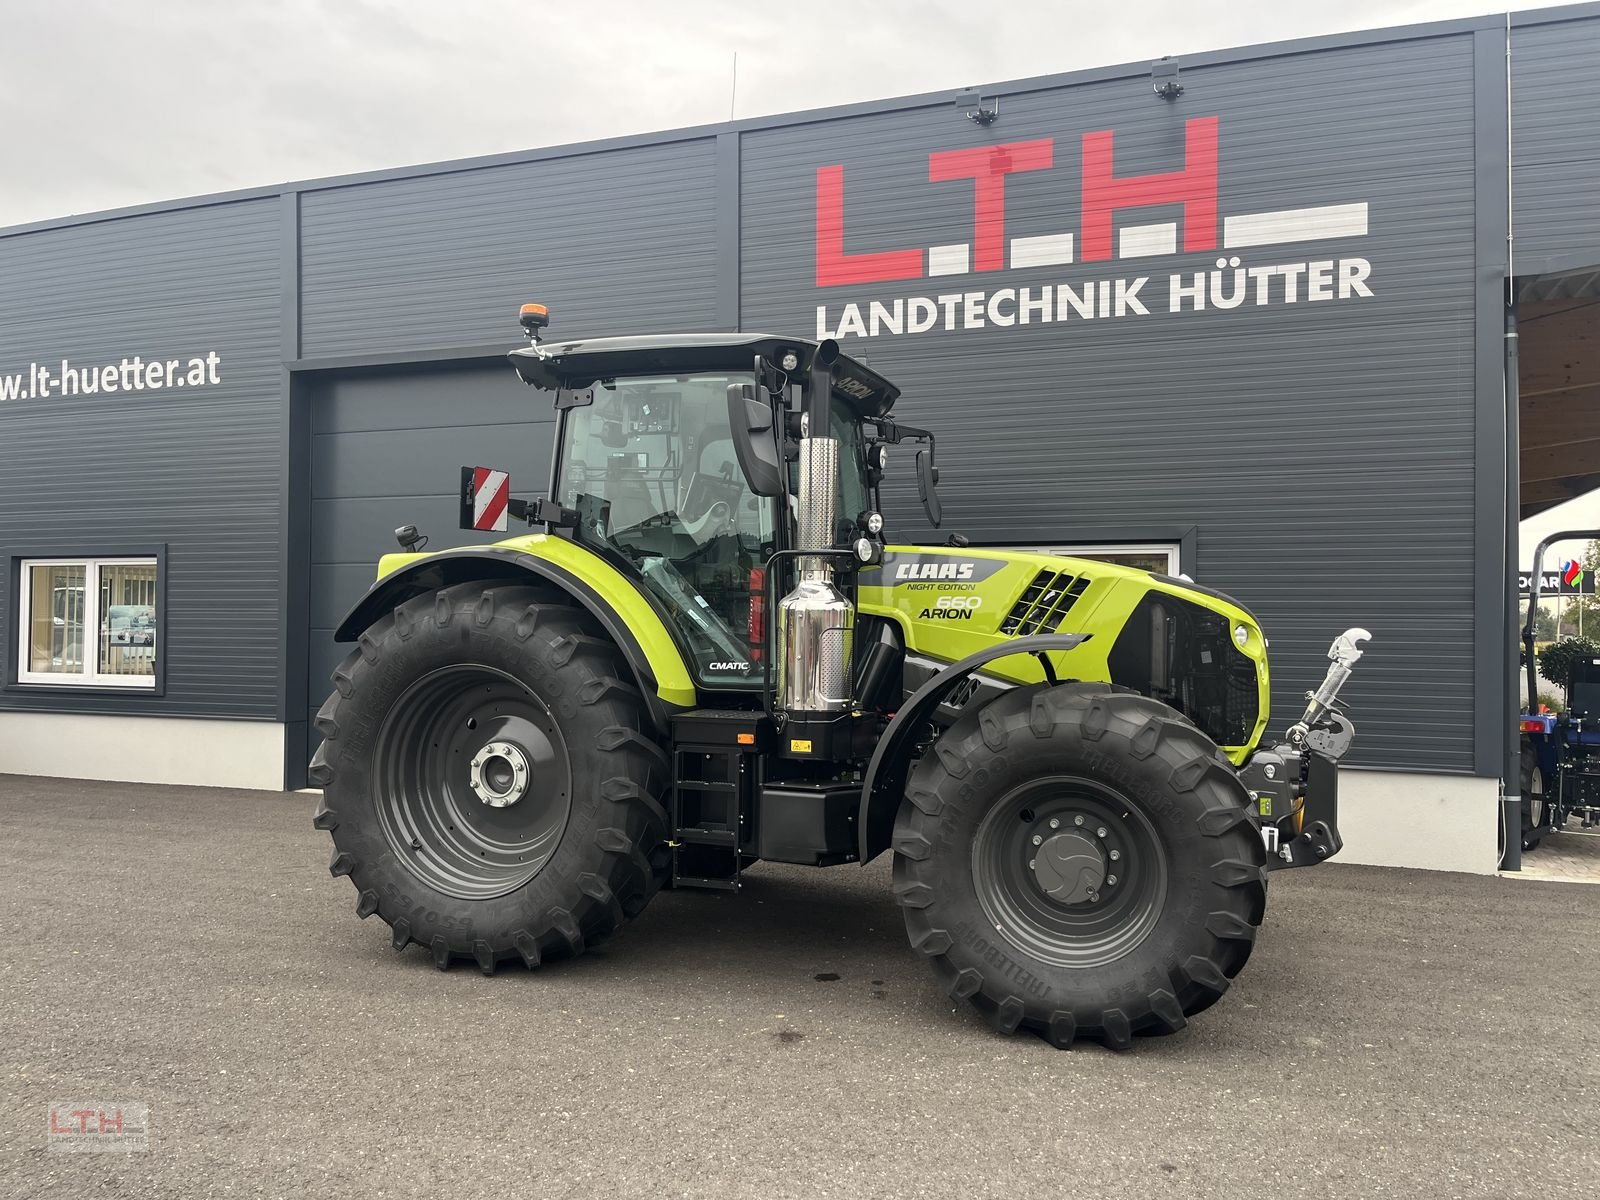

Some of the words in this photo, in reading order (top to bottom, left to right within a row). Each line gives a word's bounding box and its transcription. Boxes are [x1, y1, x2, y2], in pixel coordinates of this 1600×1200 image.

[816, 115, 1219, 288] LTH
[816, 276, 1150, 341] LANDTECHNIK
[1169, 256, 1375, 313] HÜTTER
[0, 351, 221, 400] w.lt-huetter.at
[895, 563, 975, 579] CLAAS
[907, 583, 935, 591] NIGHT
[937, 583, 976, 591] EDITION
[936, 595, 982, 609] 660
[918, 608, 972, 620] ARION
[709, 662, 750, 670] CMATIC
